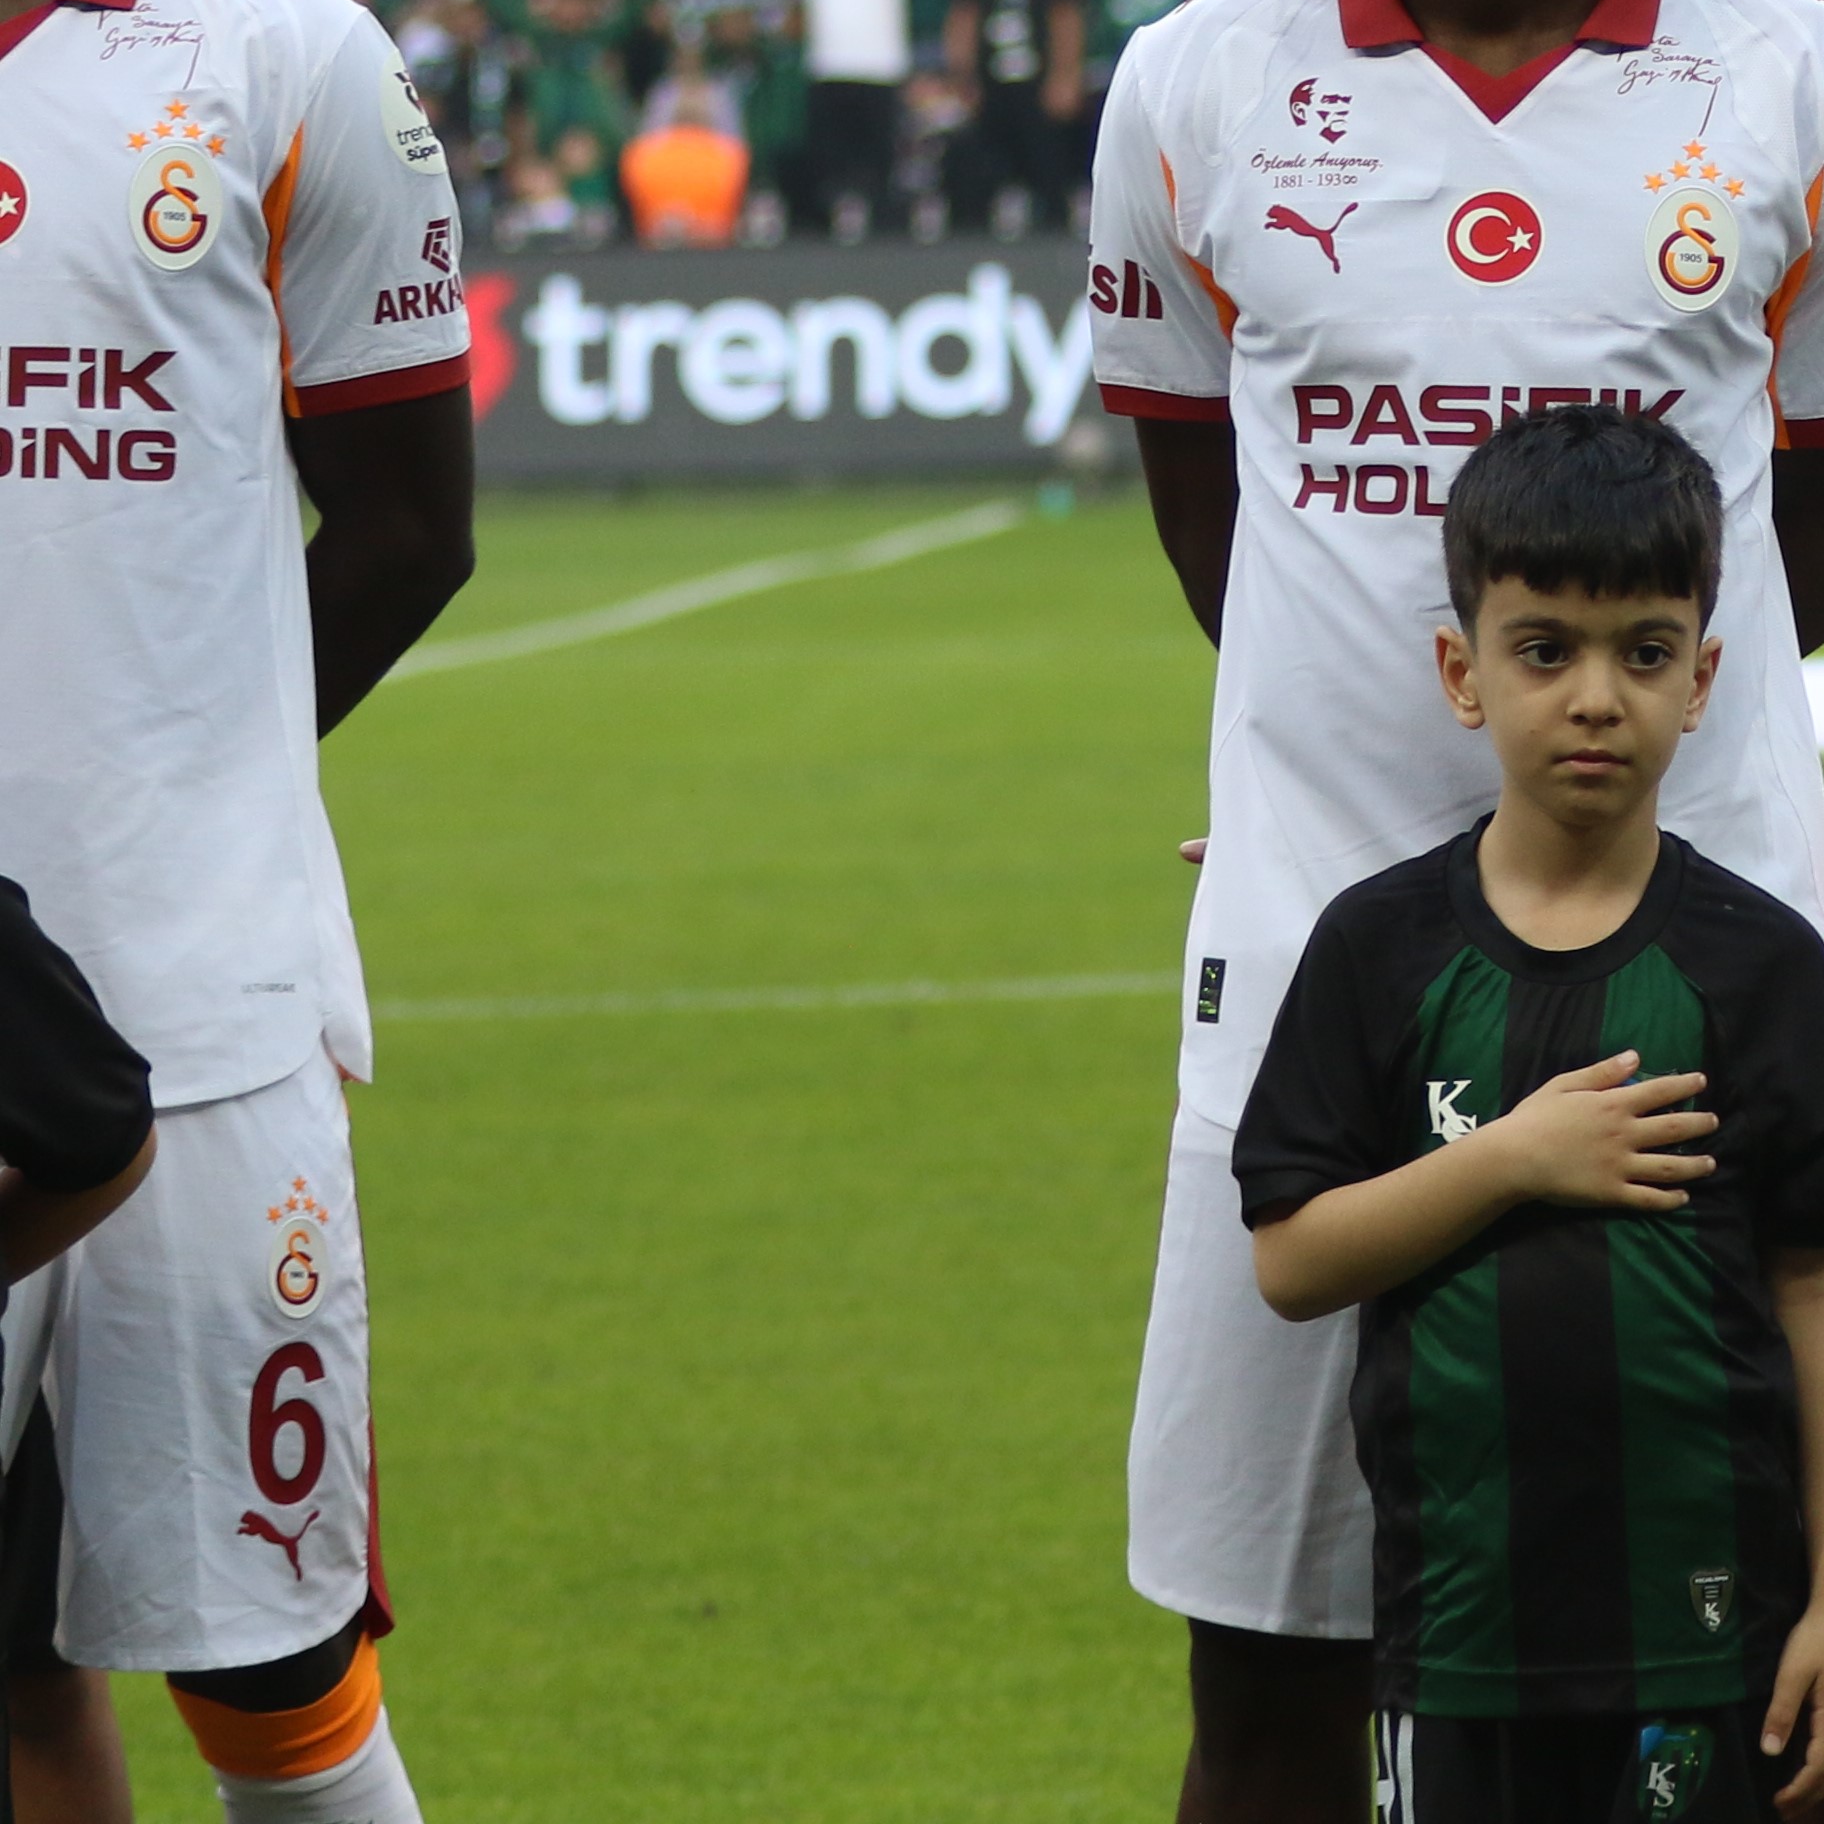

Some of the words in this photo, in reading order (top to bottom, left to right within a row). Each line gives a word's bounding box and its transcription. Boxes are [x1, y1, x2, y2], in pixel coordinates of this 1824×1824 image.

[1251, 148, 1307, 174] Özlemle
[1273, 175, 1303, 189] 1881
[1678, 252, 1703, 264] 1905
[1089, 243, 1163, 321] sli
[249, 1340, 326, 1506] 6
